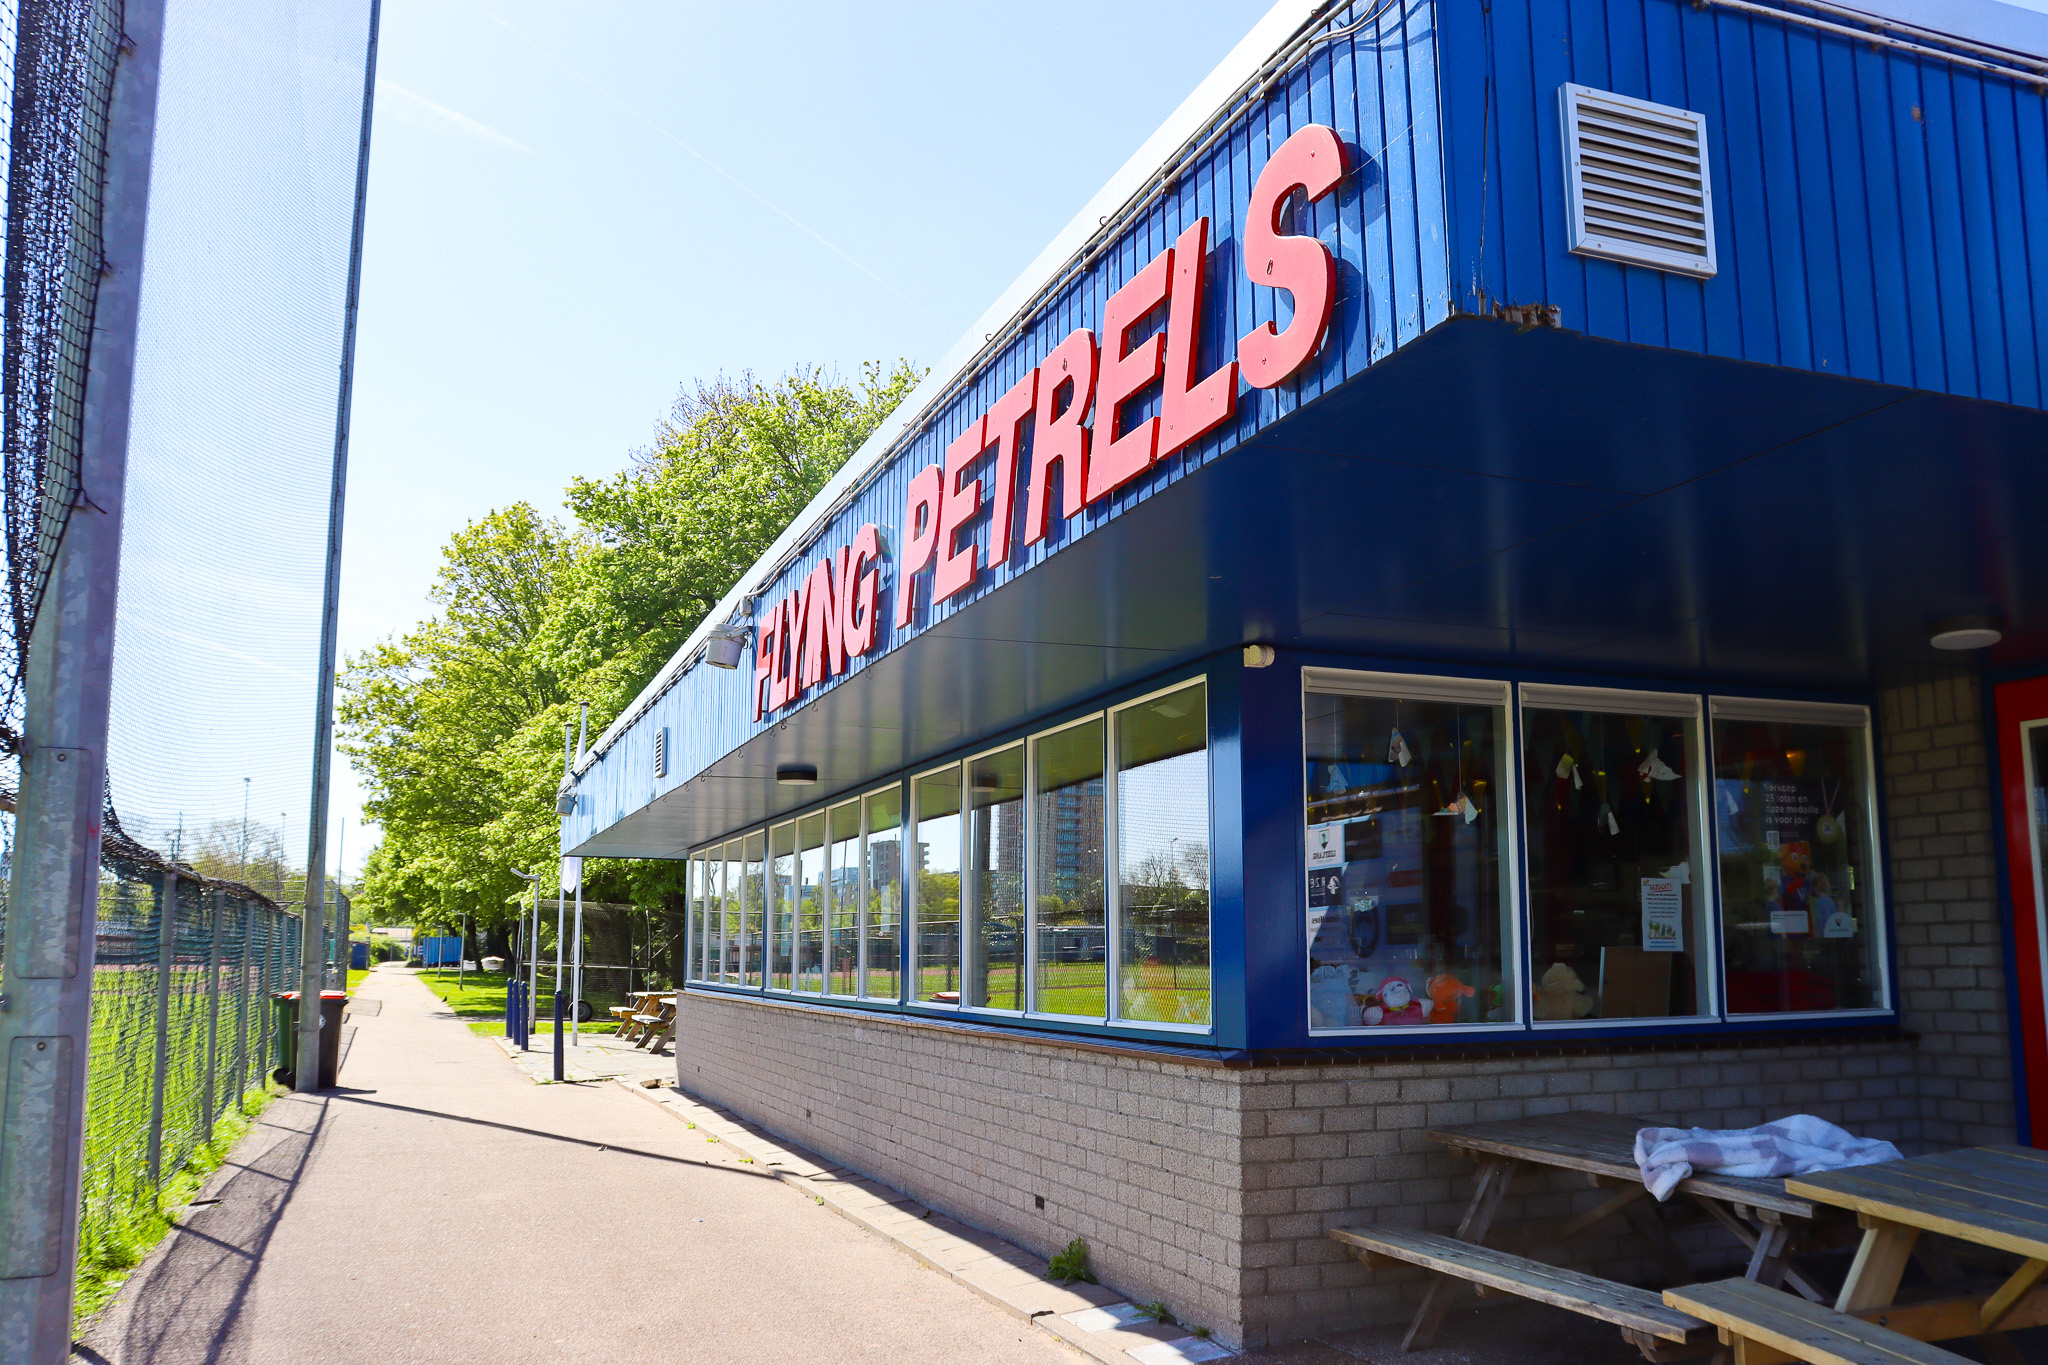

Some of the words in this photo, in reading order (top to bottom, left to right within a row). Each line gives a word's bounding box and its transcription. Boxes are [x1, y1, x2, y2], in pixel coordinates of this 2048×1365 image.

[753, 523, 880, 723] FLYING
[896, 123, 1350, 629] PETRELS
[1763, 783, 1797, 793] Verkoop
[1765, 794, 1775, 802] 25
[1777, 793, 1796, 803] loten
[1797, 795, 1808, 803] en
[1766, 804, 1785, 813] deze
[1786, 804, 1819, 814] medaille
[1766, 815, 1773, 823] is
[1774, 816, 1793, 824] voor
